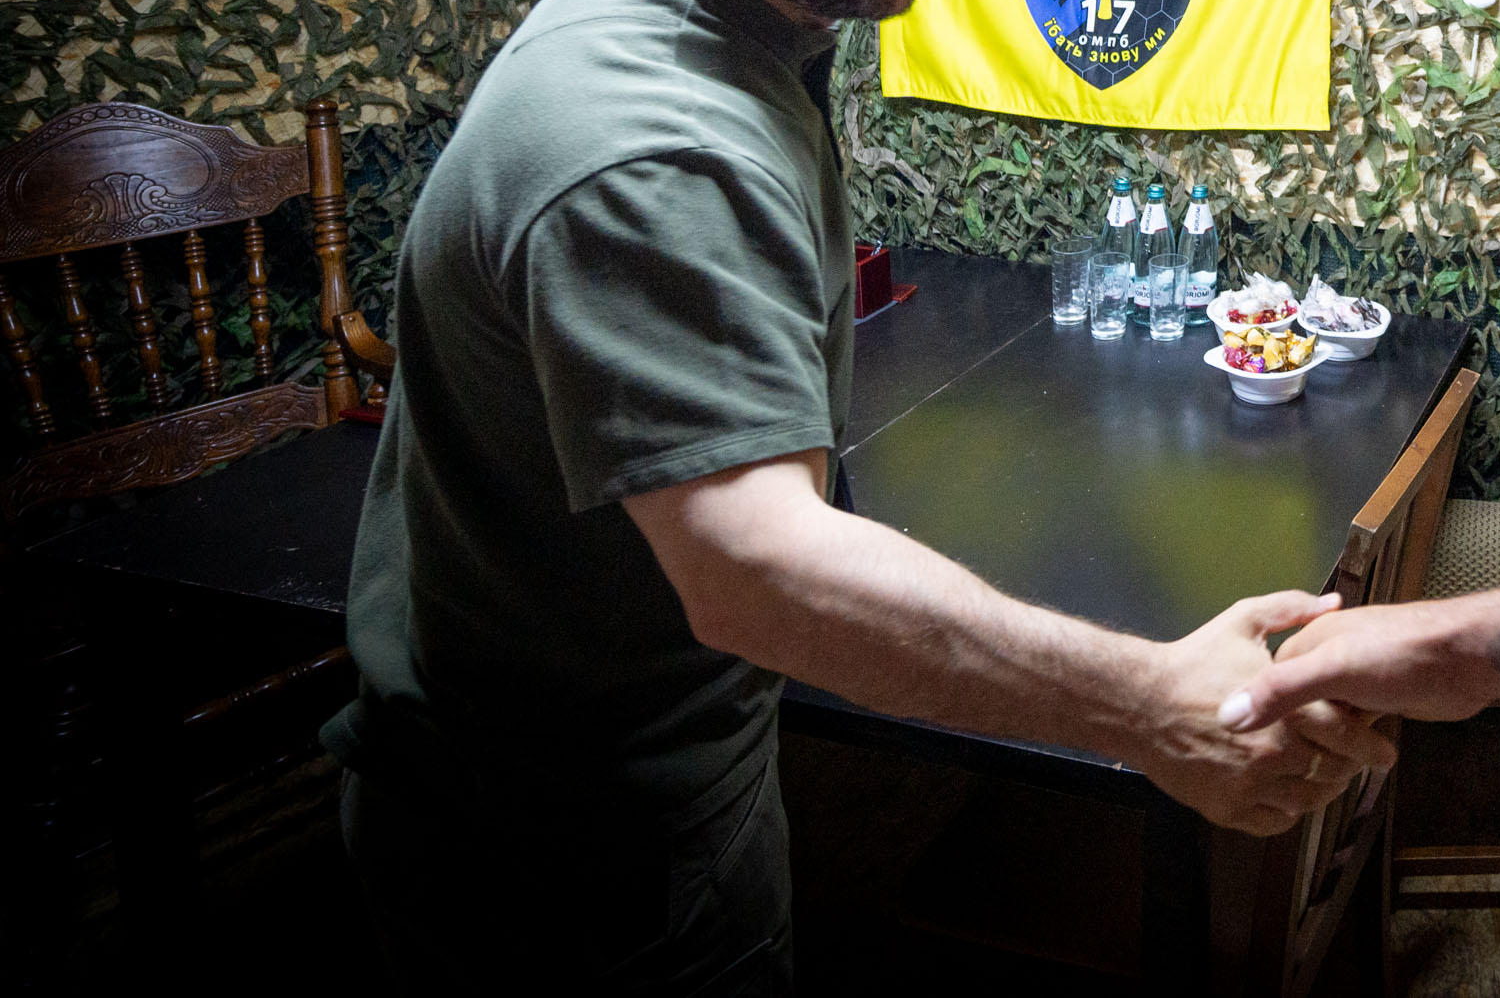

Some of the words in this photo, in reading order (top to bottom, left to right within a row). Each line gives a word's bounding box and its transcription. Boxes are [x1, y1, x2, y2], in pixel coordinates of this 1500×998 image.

[1043, 17, 1083, 58] їбать
[1089, 46, 1140, 63] знову
[1144, 27, 1166, 51] ми
[1078, 34, 1129, 48] омпб
[1186, 290, 1210, 298] ORJOMI
